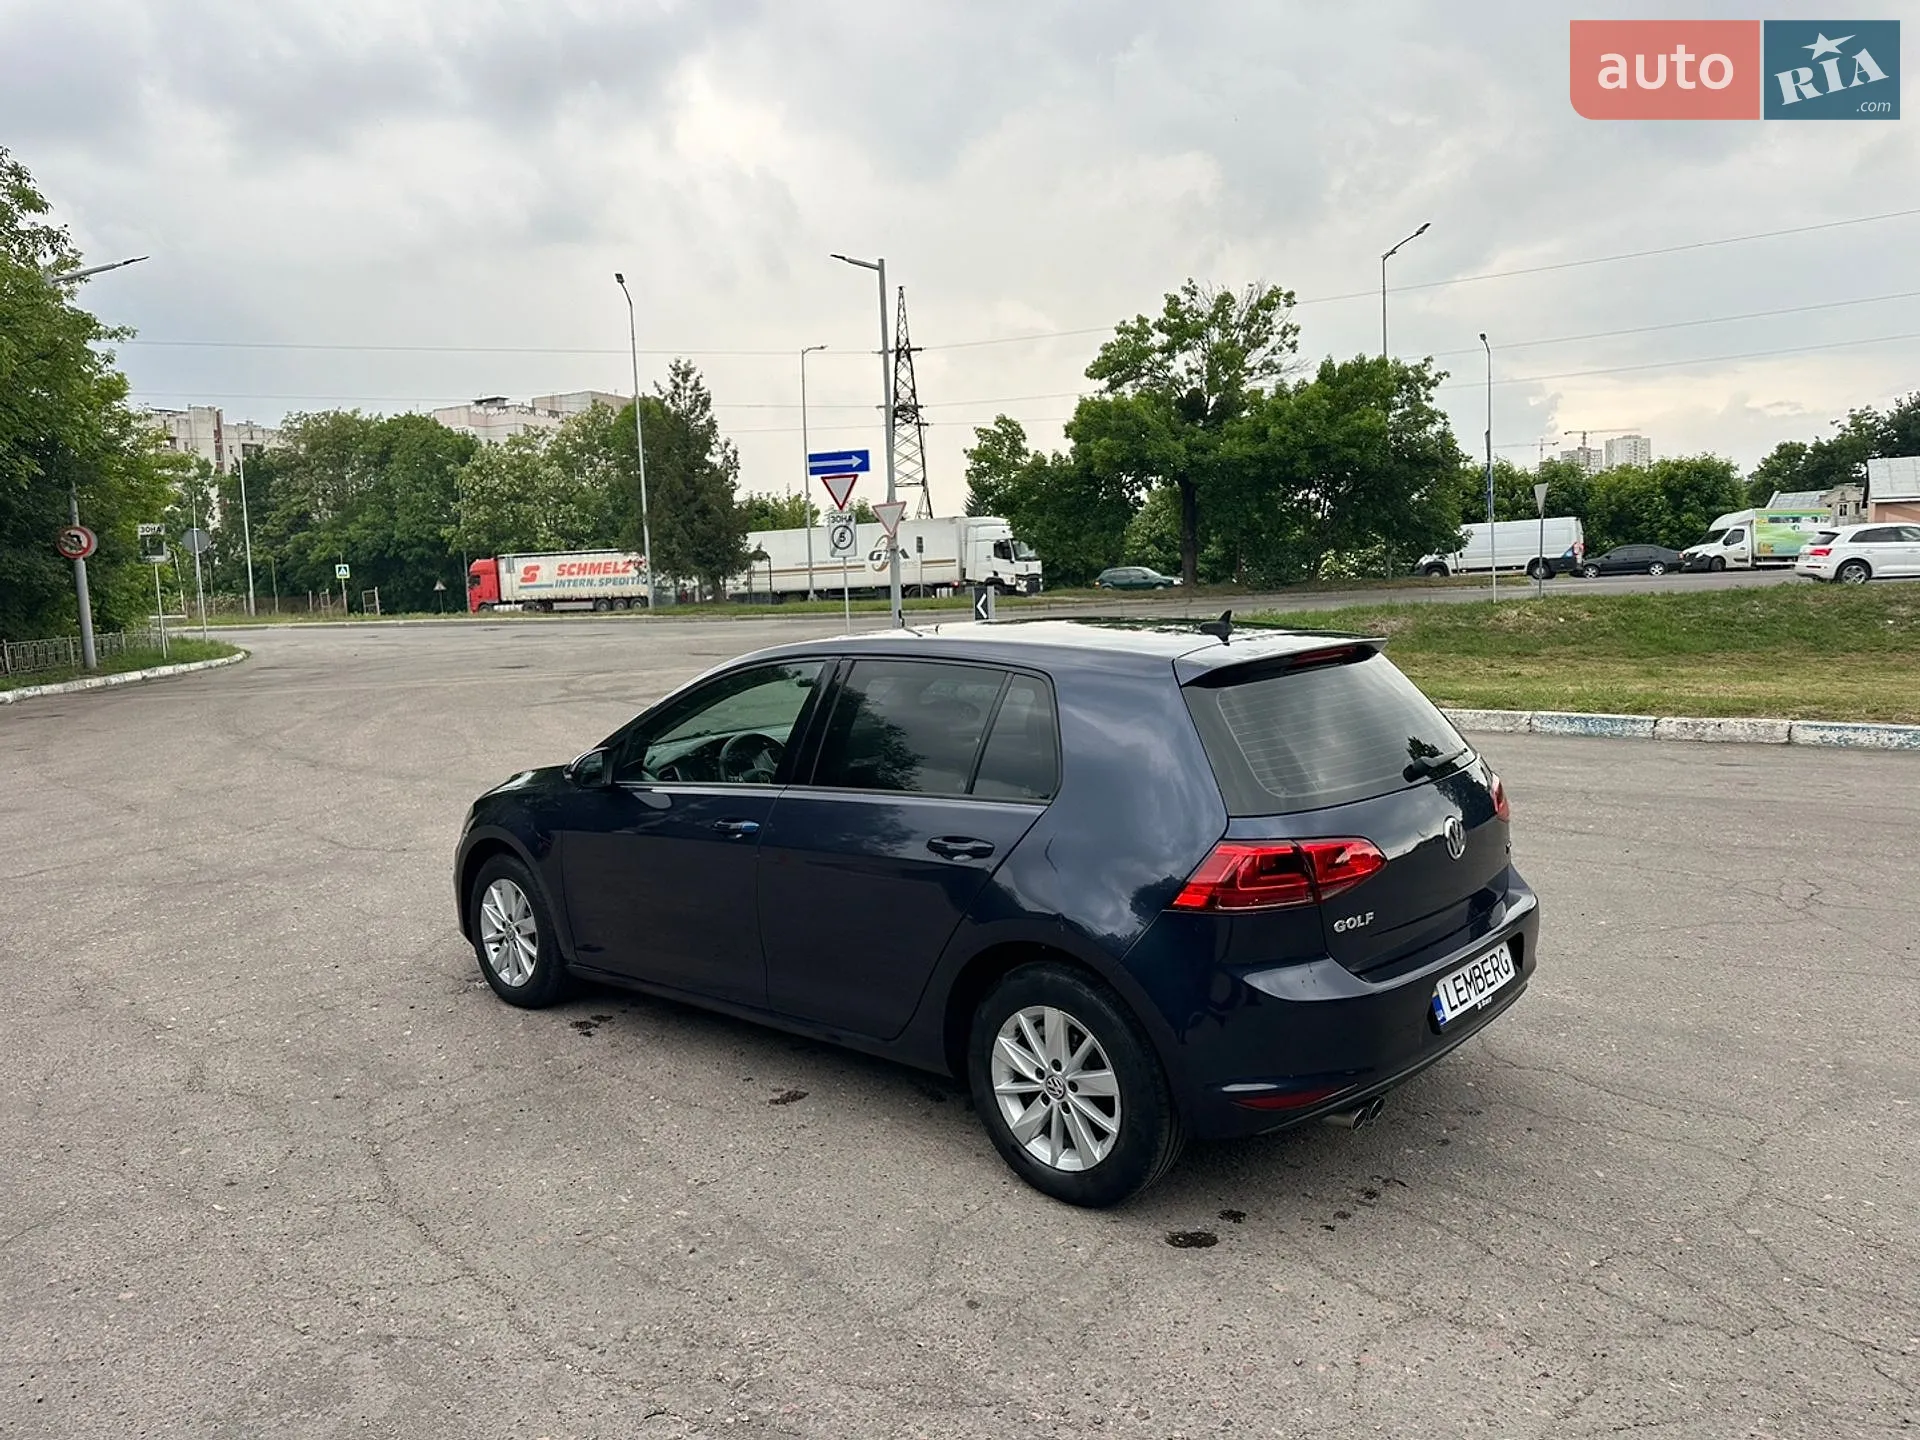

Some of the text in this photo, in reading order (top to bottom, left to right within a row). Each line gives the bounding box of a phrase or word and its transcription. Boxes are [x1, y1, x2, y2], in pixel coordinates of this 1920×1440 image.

[831, 514, 852, 524] ЗОНА
[556, 560, 644, 577] SCHMELZ
[554, 576, 647, 589] INTERN. SPEDITIO
[1333, 911, 1375, 933] GOLF
[1442, 947, 1511, 1012] LEMBERG
